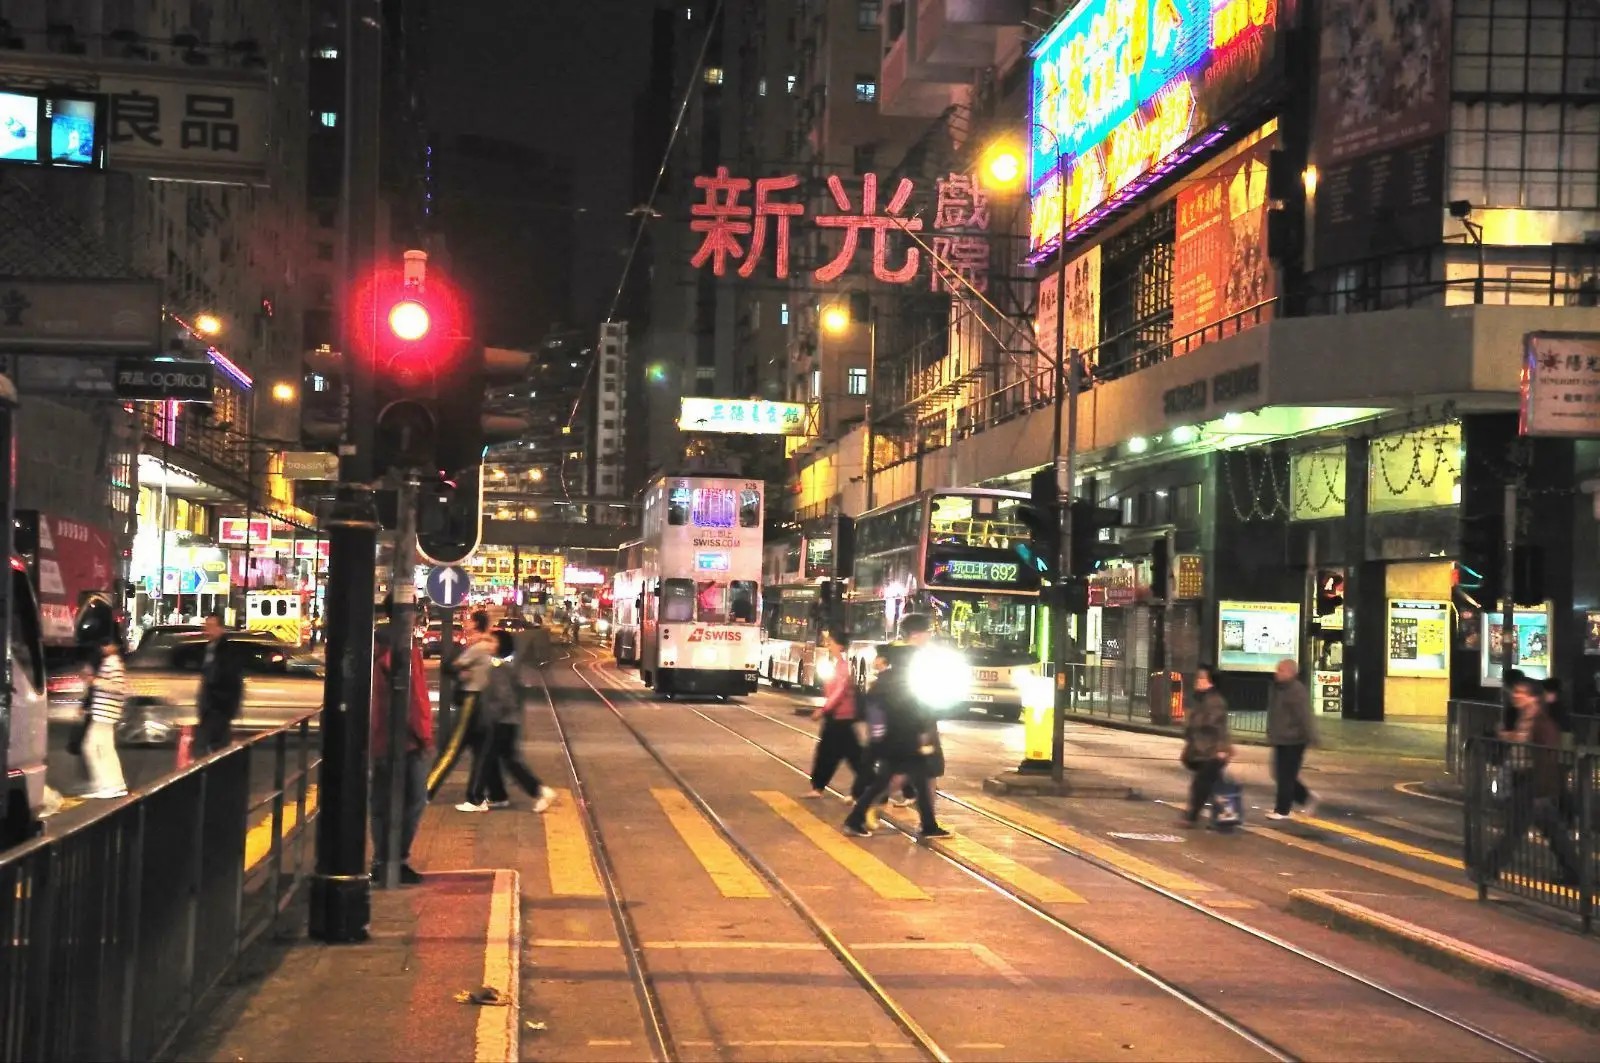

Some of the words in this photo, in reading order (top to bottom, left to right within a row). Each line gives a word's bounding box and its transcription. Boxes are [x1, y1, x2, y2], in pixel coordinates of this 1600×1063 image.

[111, 89, 239, 151] 良品
[690, 166, 924, 284] 新光
[990, 563, 1018, 582] 692
[704, 630, 743, 642] SWISS
[744, 673, 757, 682] 125
